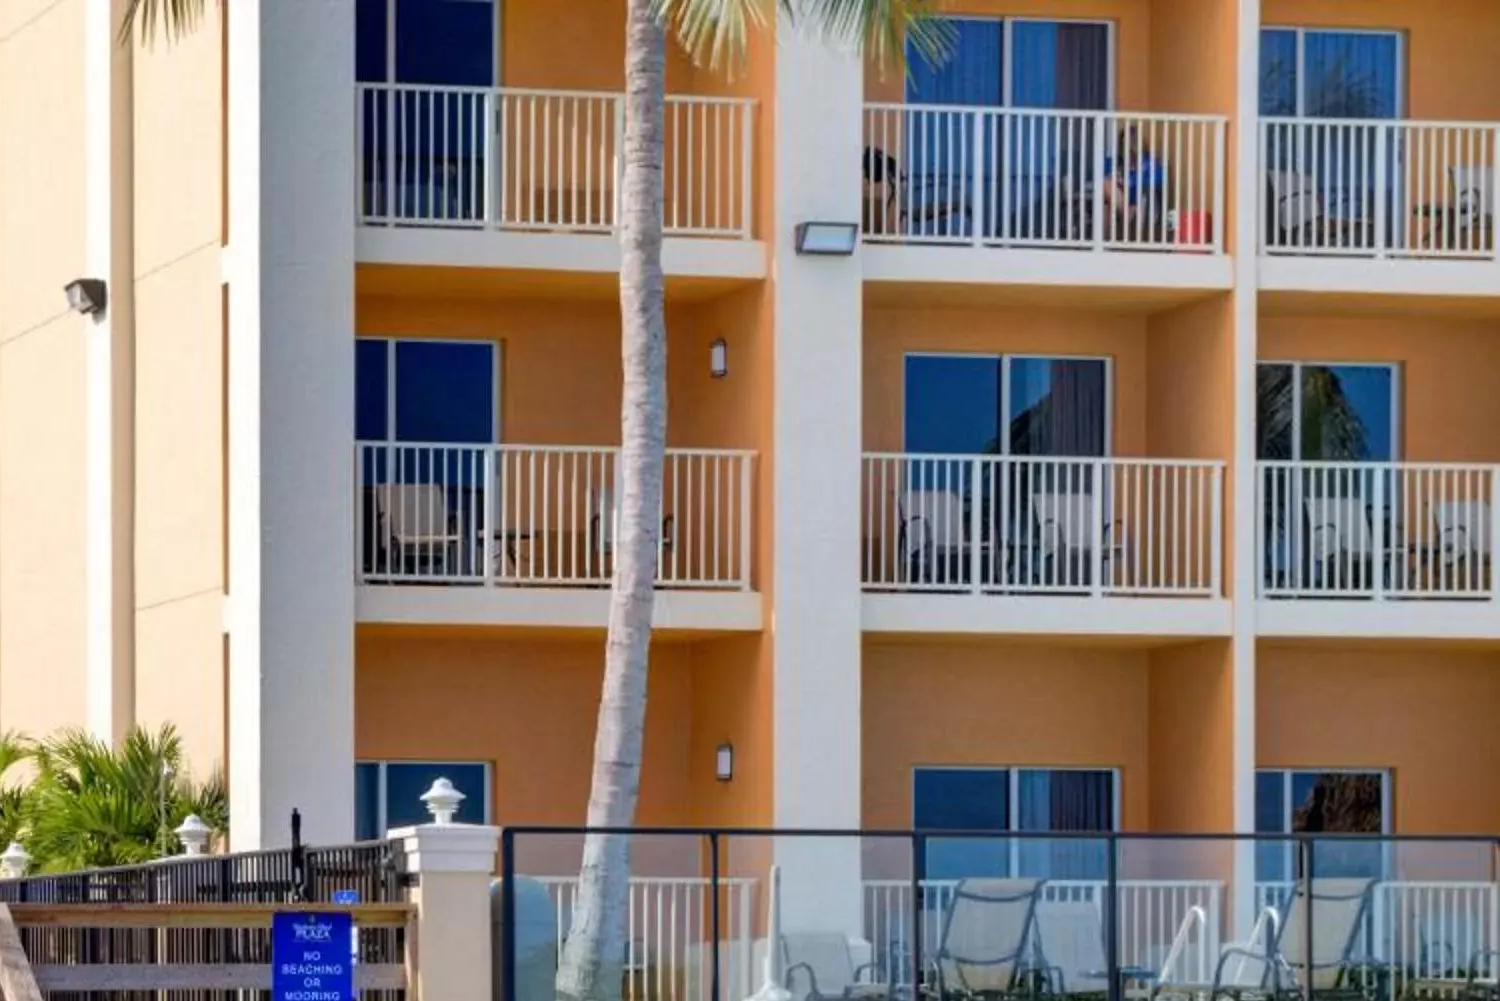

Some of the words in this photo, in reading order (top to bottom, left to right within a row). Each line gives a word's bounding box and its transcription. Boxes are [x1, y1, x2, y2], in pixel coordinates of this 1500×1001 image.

[303, 951, 321, 961] NO
[281, 964, 342, 975] BEACHING
[303, 977, 321, 988] OR
[284, 991, 341, 1001] MOORING
